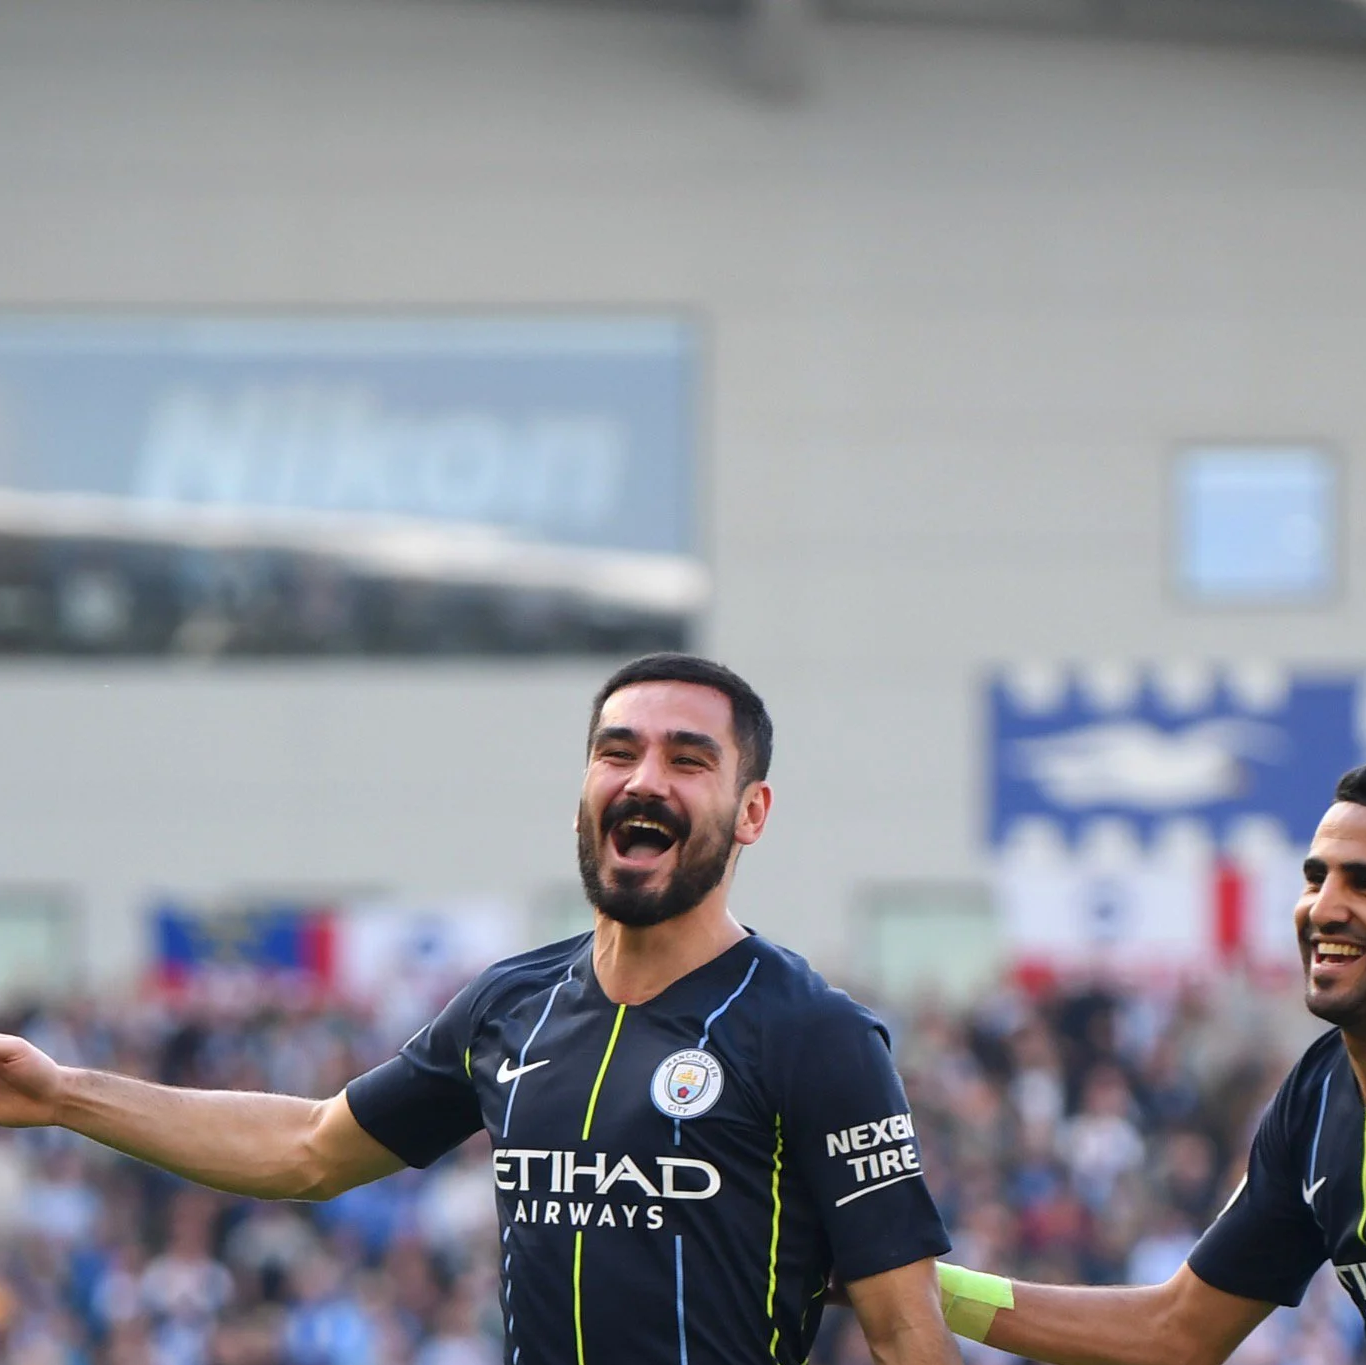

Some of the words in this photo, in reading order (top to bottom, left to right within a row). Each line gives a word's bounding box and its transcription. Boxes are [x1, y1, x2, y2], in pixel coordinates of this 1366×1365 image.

[666, 1053, 719, 1078] MANCHESTER
[668, 1104, 689, 1114] CITY
[826, 1113, 915, 1158] NEXEN
[493, 1149, 722, 1200] ETIHAD
[847, 1144, 920, 1182] TIRE
[514, 1199, 664, 1230] AIRWAYS
